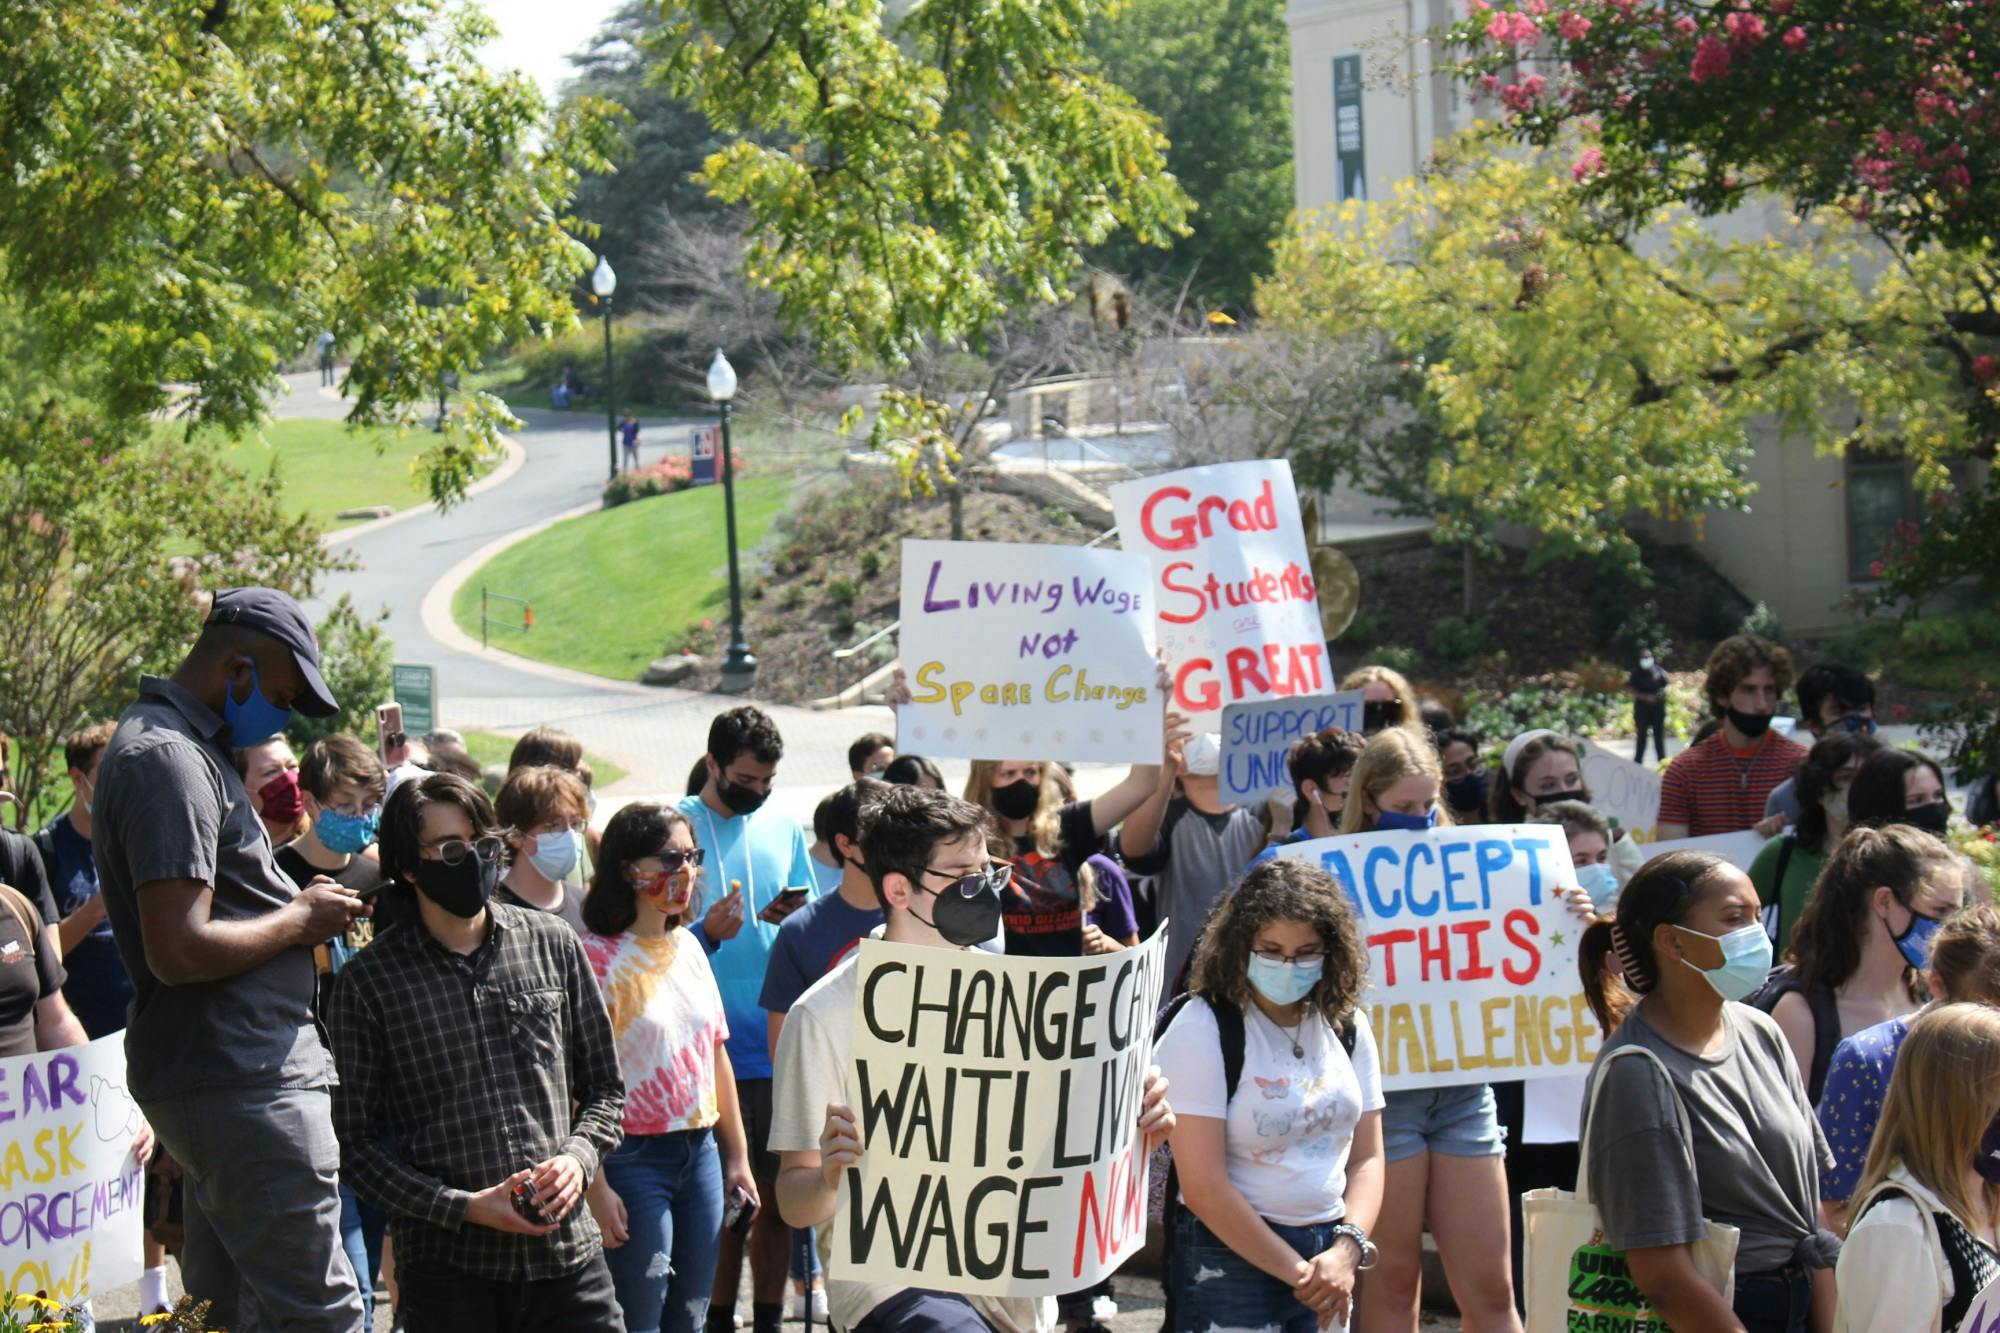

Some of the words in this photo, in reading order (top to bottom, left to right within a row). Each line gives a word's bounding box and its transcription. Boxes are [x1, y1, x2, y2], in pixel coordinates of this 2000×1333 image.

[1140, 479, 1279, 551] Grad
[1159, 562, 1316, 624] Students
[1045, 664, 1147, 710] Change
[1174, 644, 1323, 712] GREAT
[1231, 703, 1358, 745] SUPPORT
[1321, 838, 1550, 918] ACCEPT
[1366, 908, 1542, 986] THIS
[863, 961, 1106, 1061] CHANGE
[856, 1060, 1029, 1169] WAIT!
[848, 1167, 1063, 1280] WAGE
